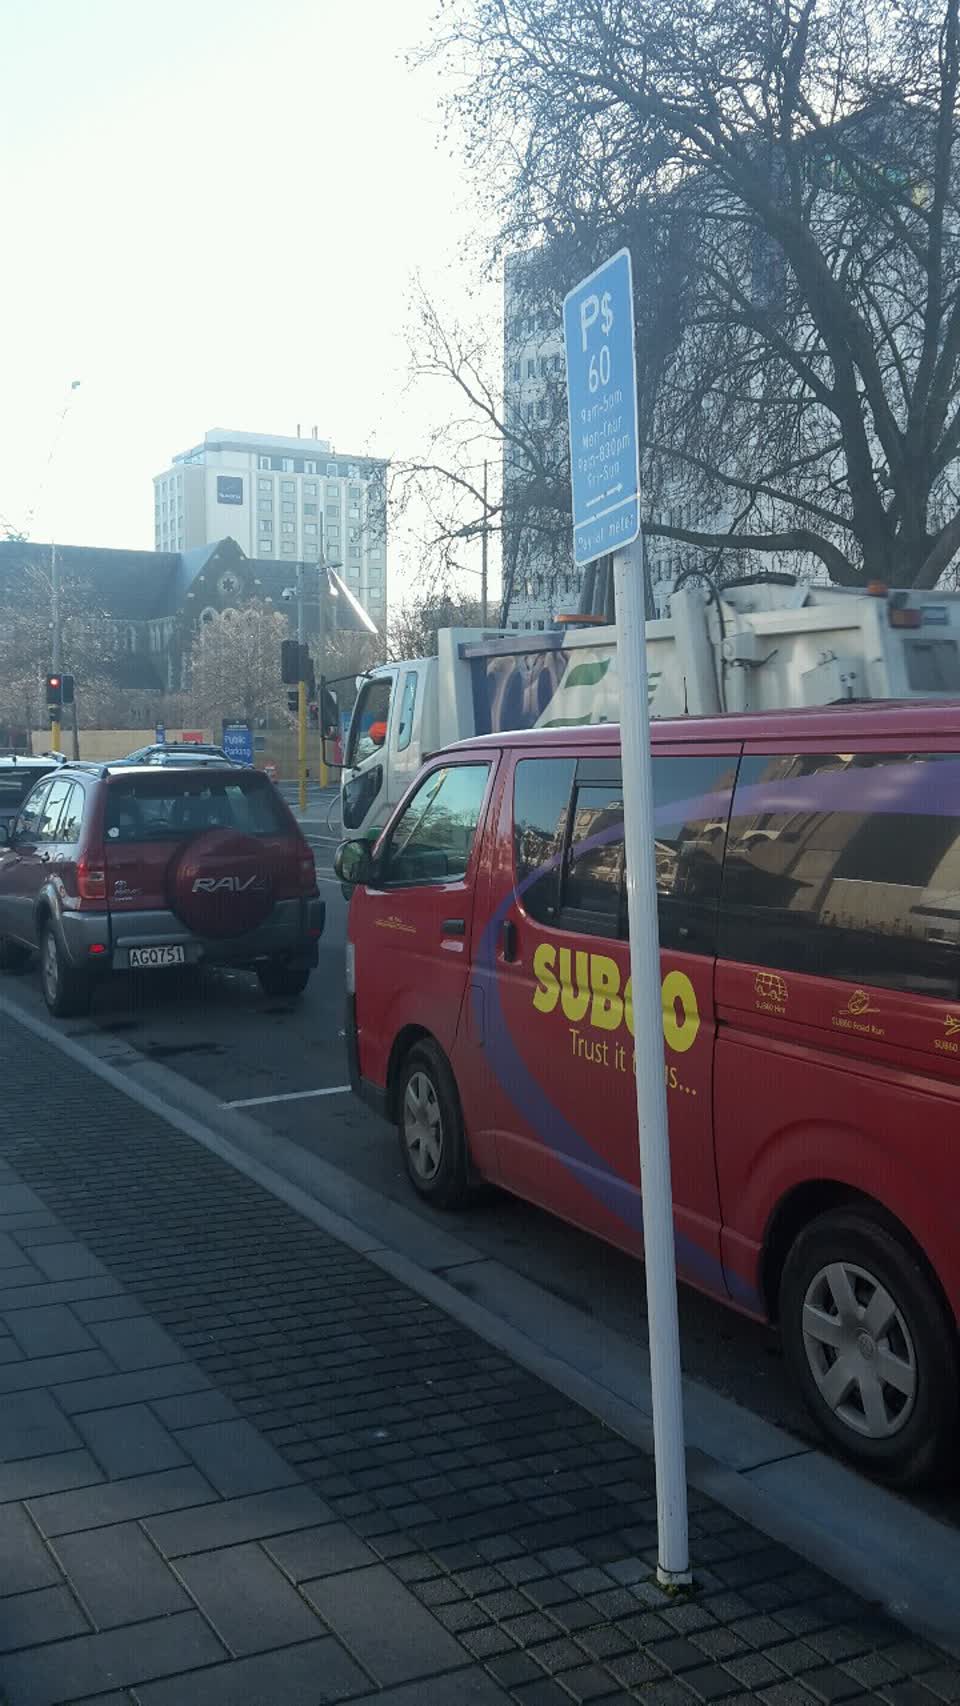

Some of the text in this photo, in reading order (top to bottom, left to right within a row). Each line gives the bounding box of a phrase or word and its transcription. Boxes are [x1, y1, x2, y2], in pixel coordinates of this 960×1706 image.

[589, 344, 610, 392] 60
[582, 415, 622, 449] Mon-Thur
[587, 461, 620, 489] Fri-Sun
[224, 734, 247, 745] Public
[224, 747, 252, 758] Parking
[131, 946, 183, 966] AGQ751
[569, 1028, 609, 1066] Trust
[615, 1041, 627, 1073] it
